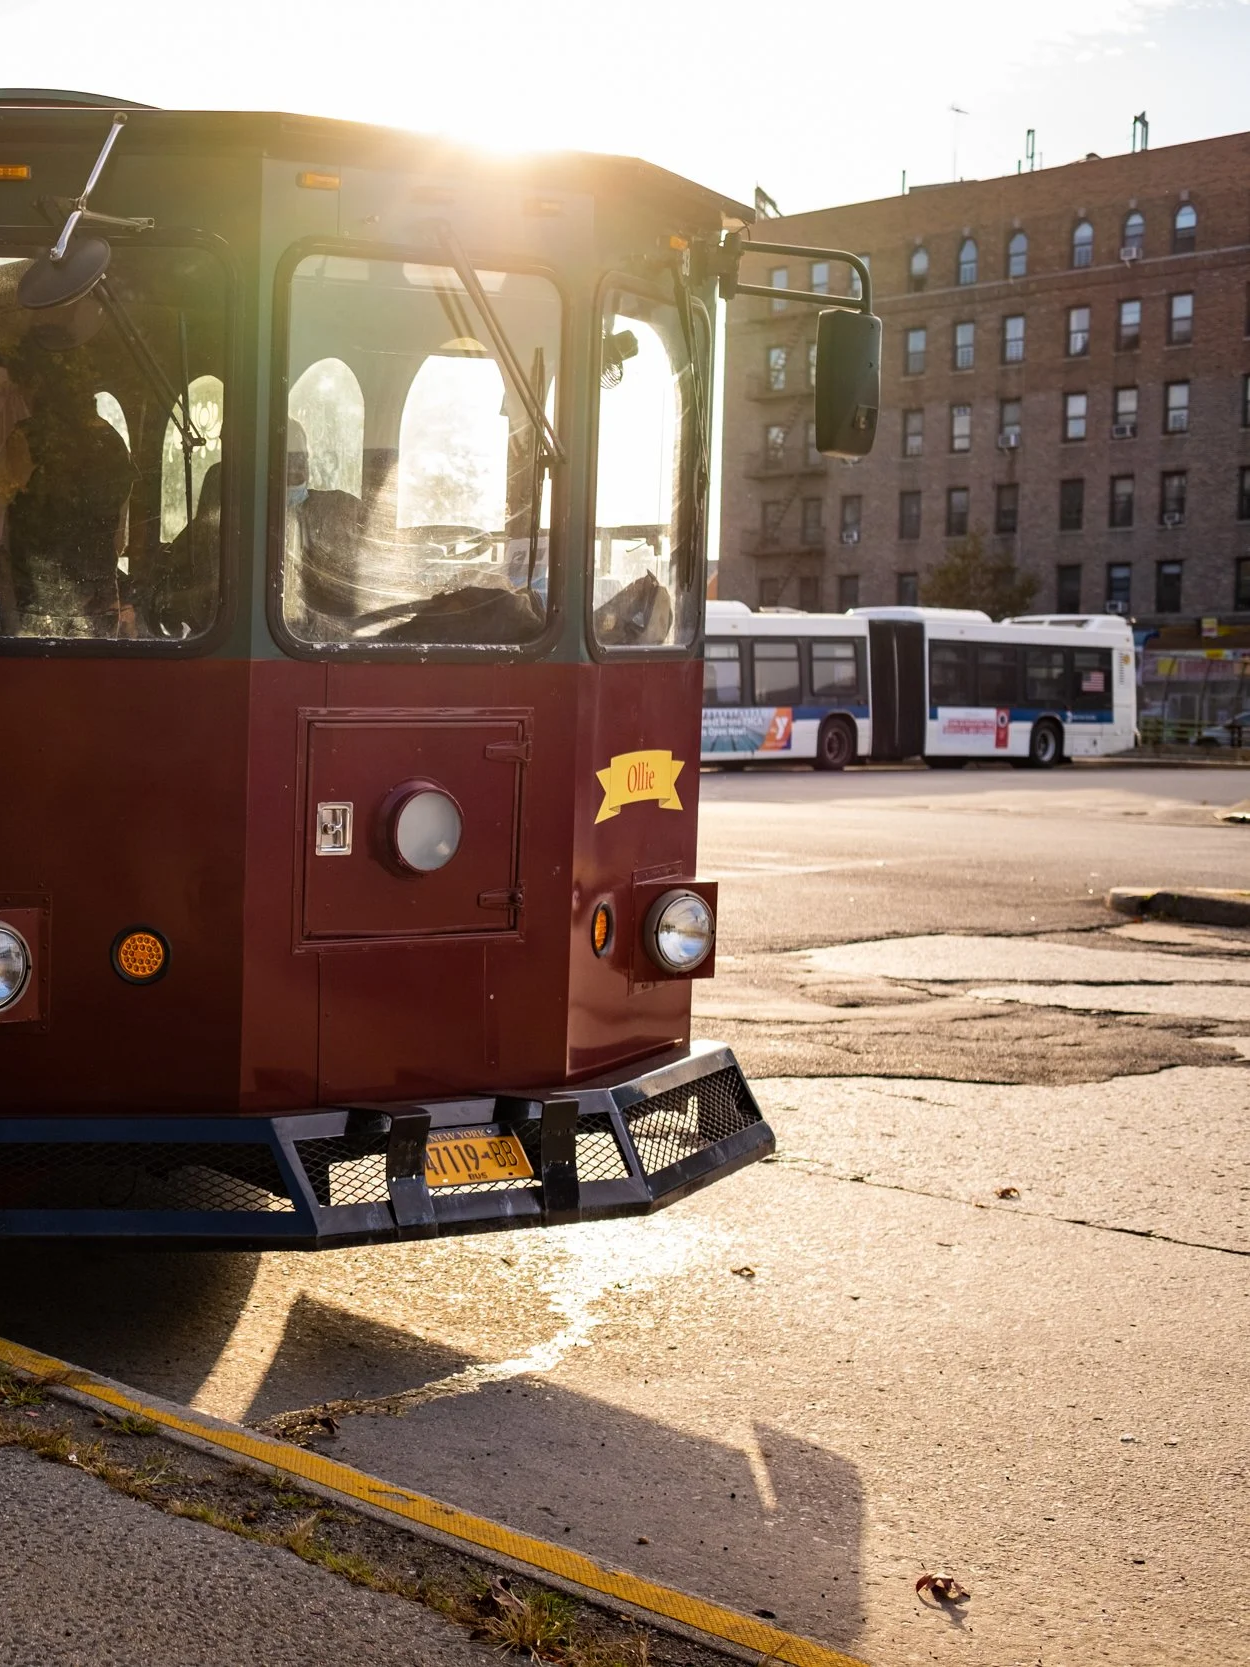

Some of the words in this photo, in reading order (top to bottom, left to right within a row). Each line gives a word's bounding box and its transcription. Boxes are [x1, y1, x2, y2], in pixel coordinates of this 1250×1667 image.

[628, 762, 654, 793] Ollie
[429, 1132, 455, 1142] NEW
[458, 1128, 486, 1140] YORK
